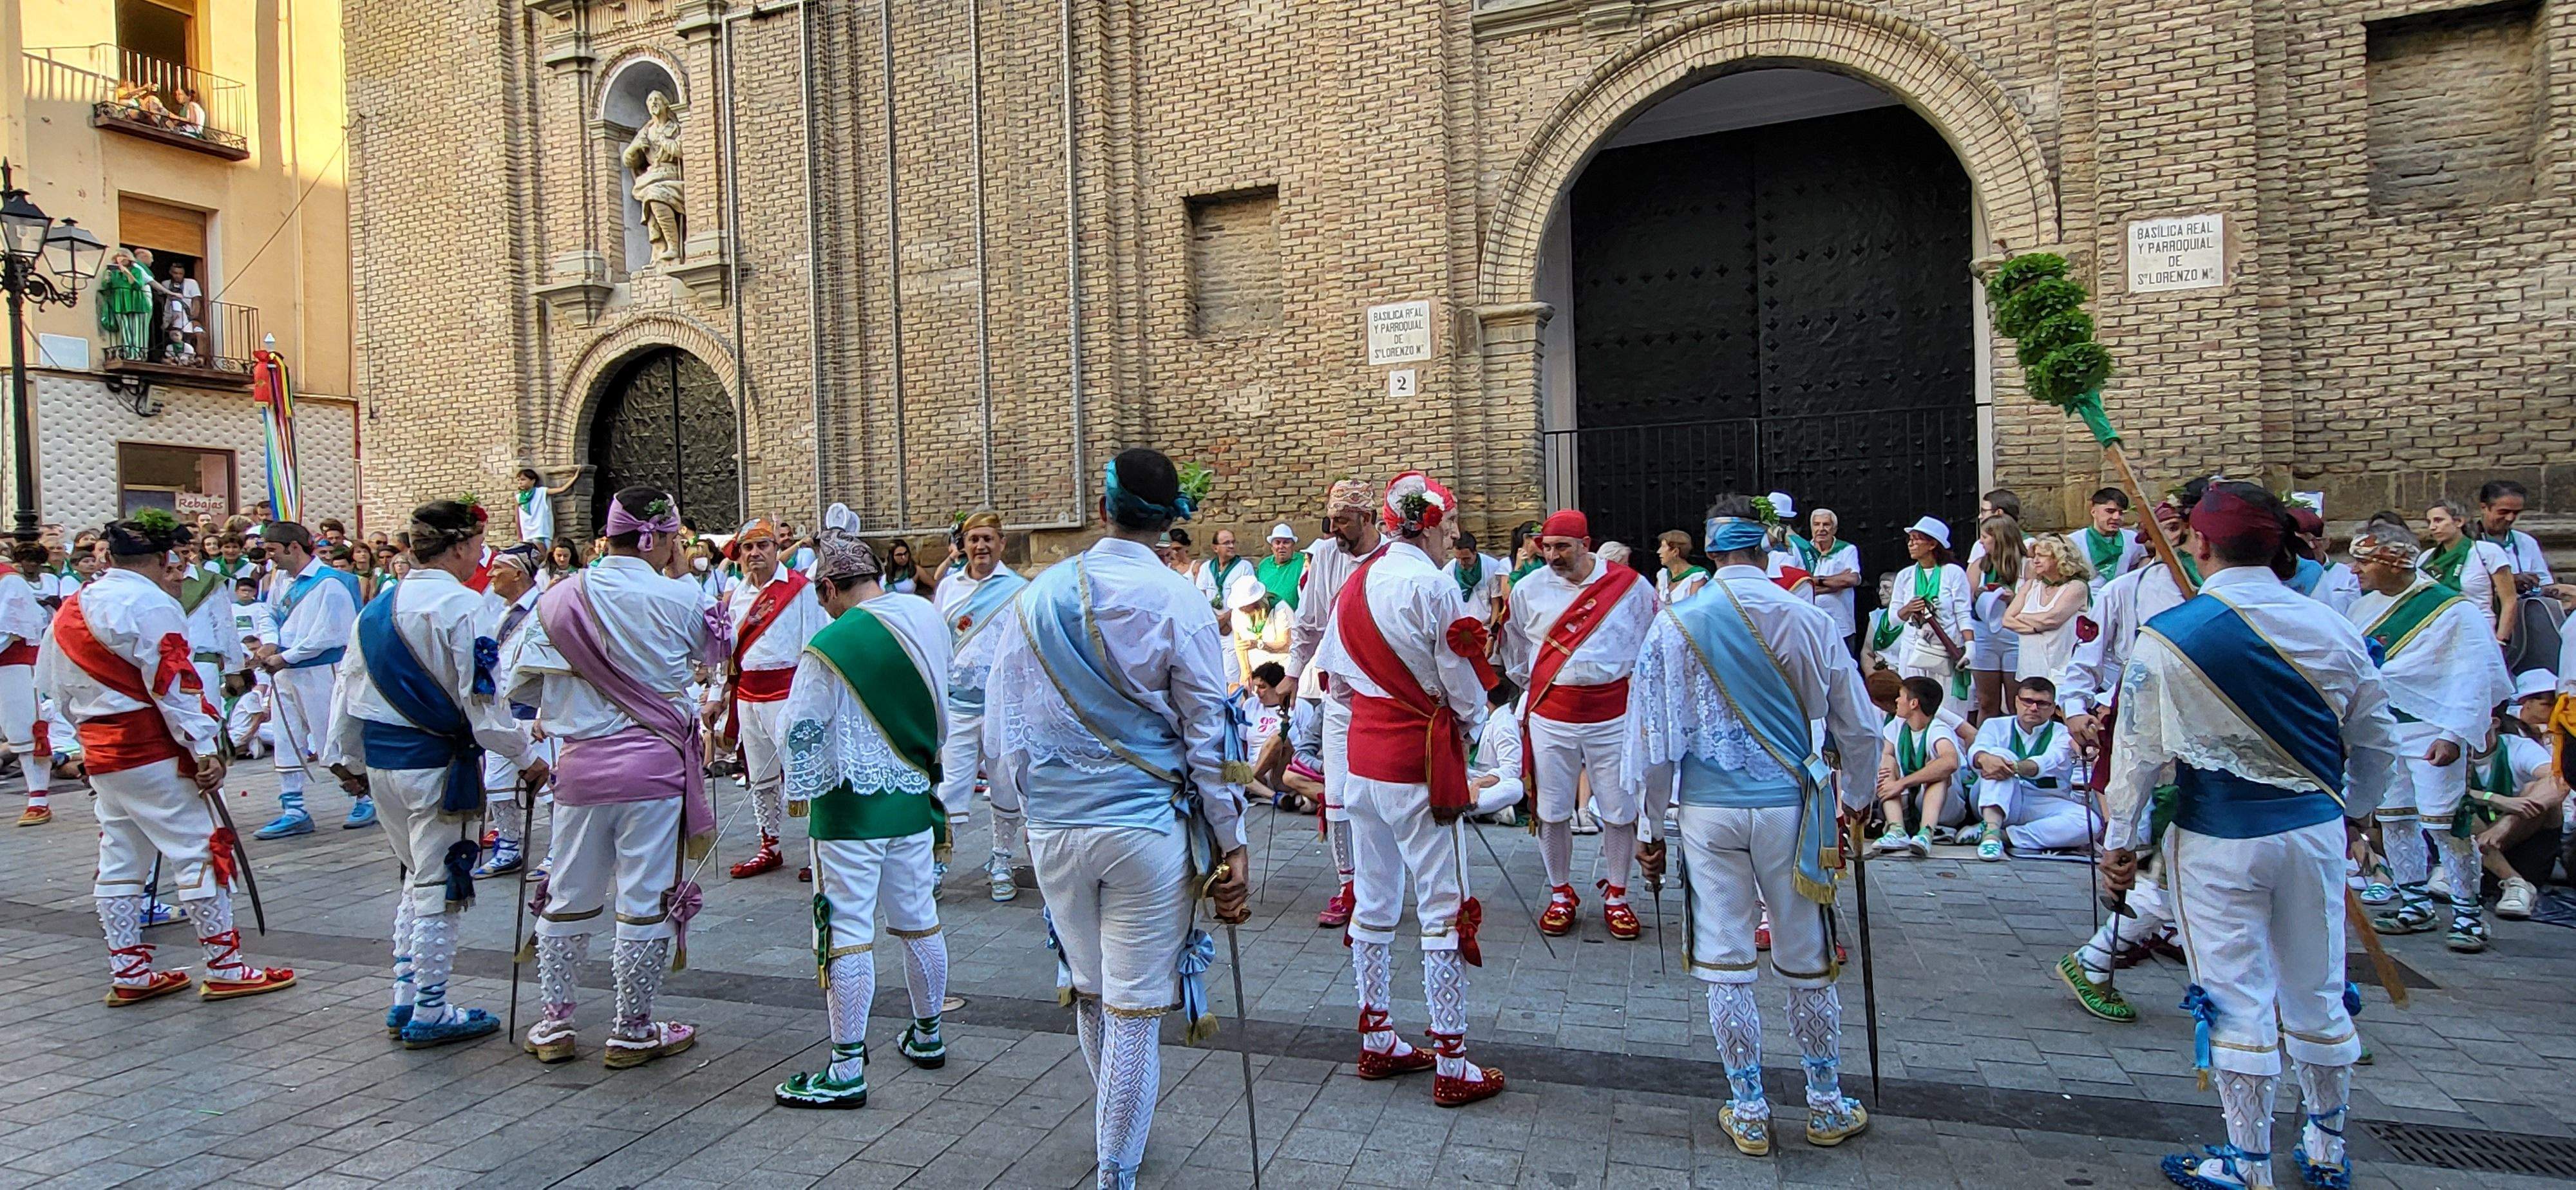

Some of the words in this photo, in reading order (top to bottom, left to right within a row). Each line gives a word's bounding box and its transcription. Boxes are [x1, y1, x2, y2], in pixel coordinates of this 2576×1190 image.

[2137, 225, 2183, 240] BASÍLICA
[2187, 222, 2213, 235] REAL
[2138, 243, 2144, 254] Y
[2148, 237, 2214, 254] PARROQUIAL
[2168, 255, 2183, 267] DE
[2149, 269, 2197, 284] LORENZO
[1406, 308, 1423, 319] REAL
[1374, 325, 1379, 334] Y
[1381, 321, 1424, 334] PARROQUIAL
[1394, 334, 1403, 344] DE
[1382, 346, 1414, 358] LORENZO
[1397, 376, 1406, 390] 2
[179, 498, 223, 511] Rebajas
